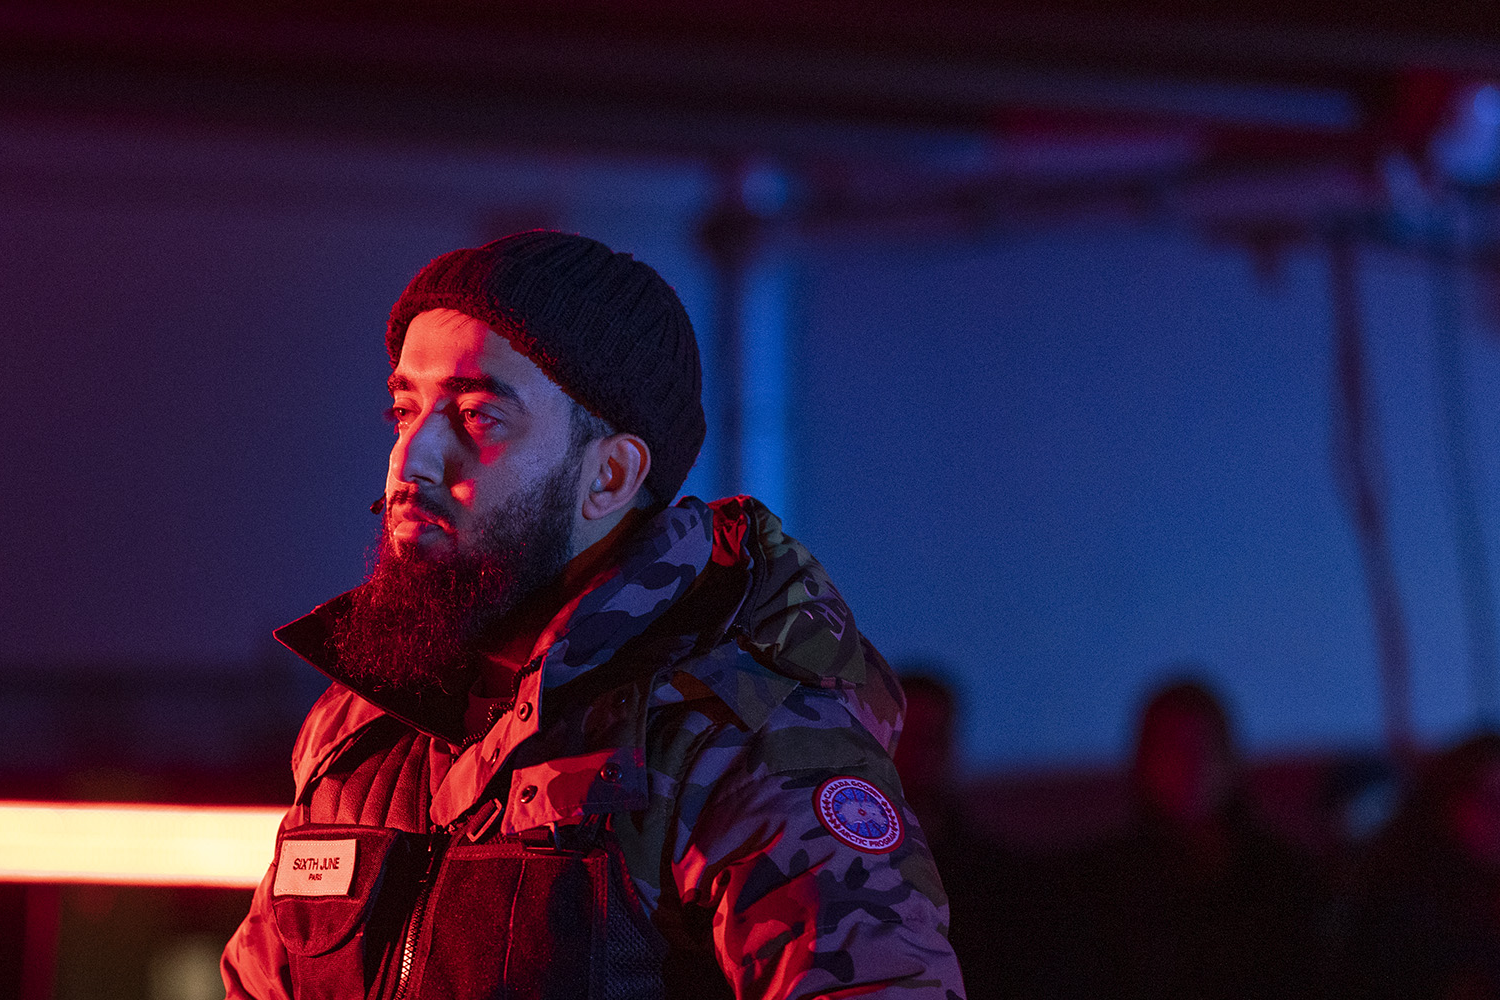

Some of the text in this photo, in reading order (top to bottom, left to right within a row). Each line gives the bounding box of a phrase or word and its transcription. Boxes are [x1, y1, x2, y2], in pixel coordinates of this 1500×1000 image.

[823, 780, 851, 800] CANADA
[838, 828, 897, 848] ARCTIC PROGRAM
[292, 857, 341, 871] SIXTH JUNE
[308, 873, 323, 881] PARIS
